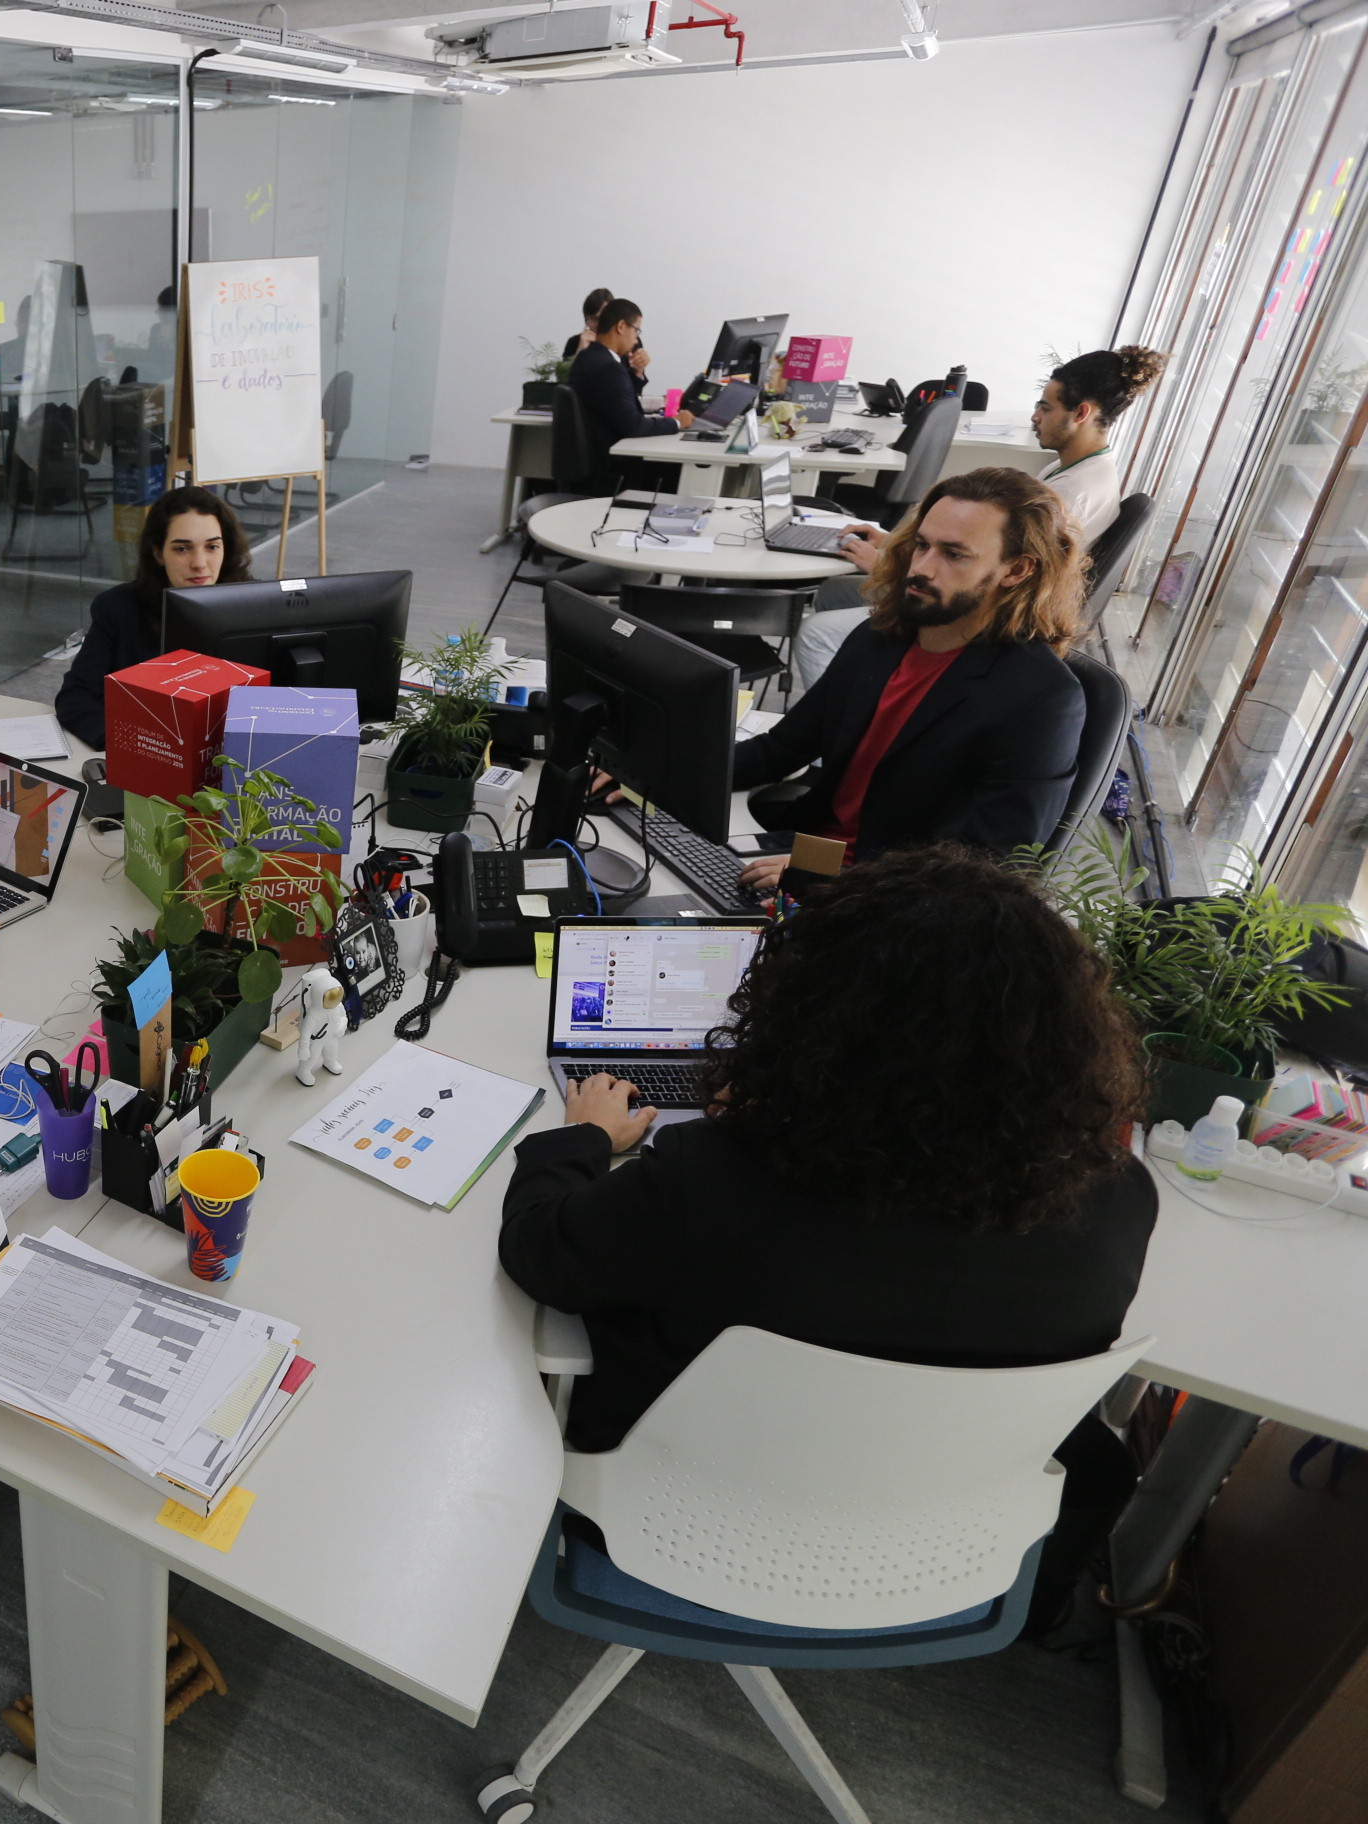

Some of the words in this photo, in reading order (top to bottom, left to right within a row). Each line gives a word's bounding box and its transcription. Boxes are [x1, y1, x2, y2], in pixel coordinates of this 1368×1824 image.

[232, 280, 264, 302] IRIS
[210, 352, 226, 368] DE
[798, 393, 815, 401] INTE
[137, 734, 171, 750] INTEGRAÇÃO
[141, 742, 183, 761] PLANEJAMENTO
[146, 751, 172, 765] GOVERNO
[234, 784, 295, 800] TANS
[129, 816, 147, 841] INTE
[239, 879, 322, 901] CONSTRU
